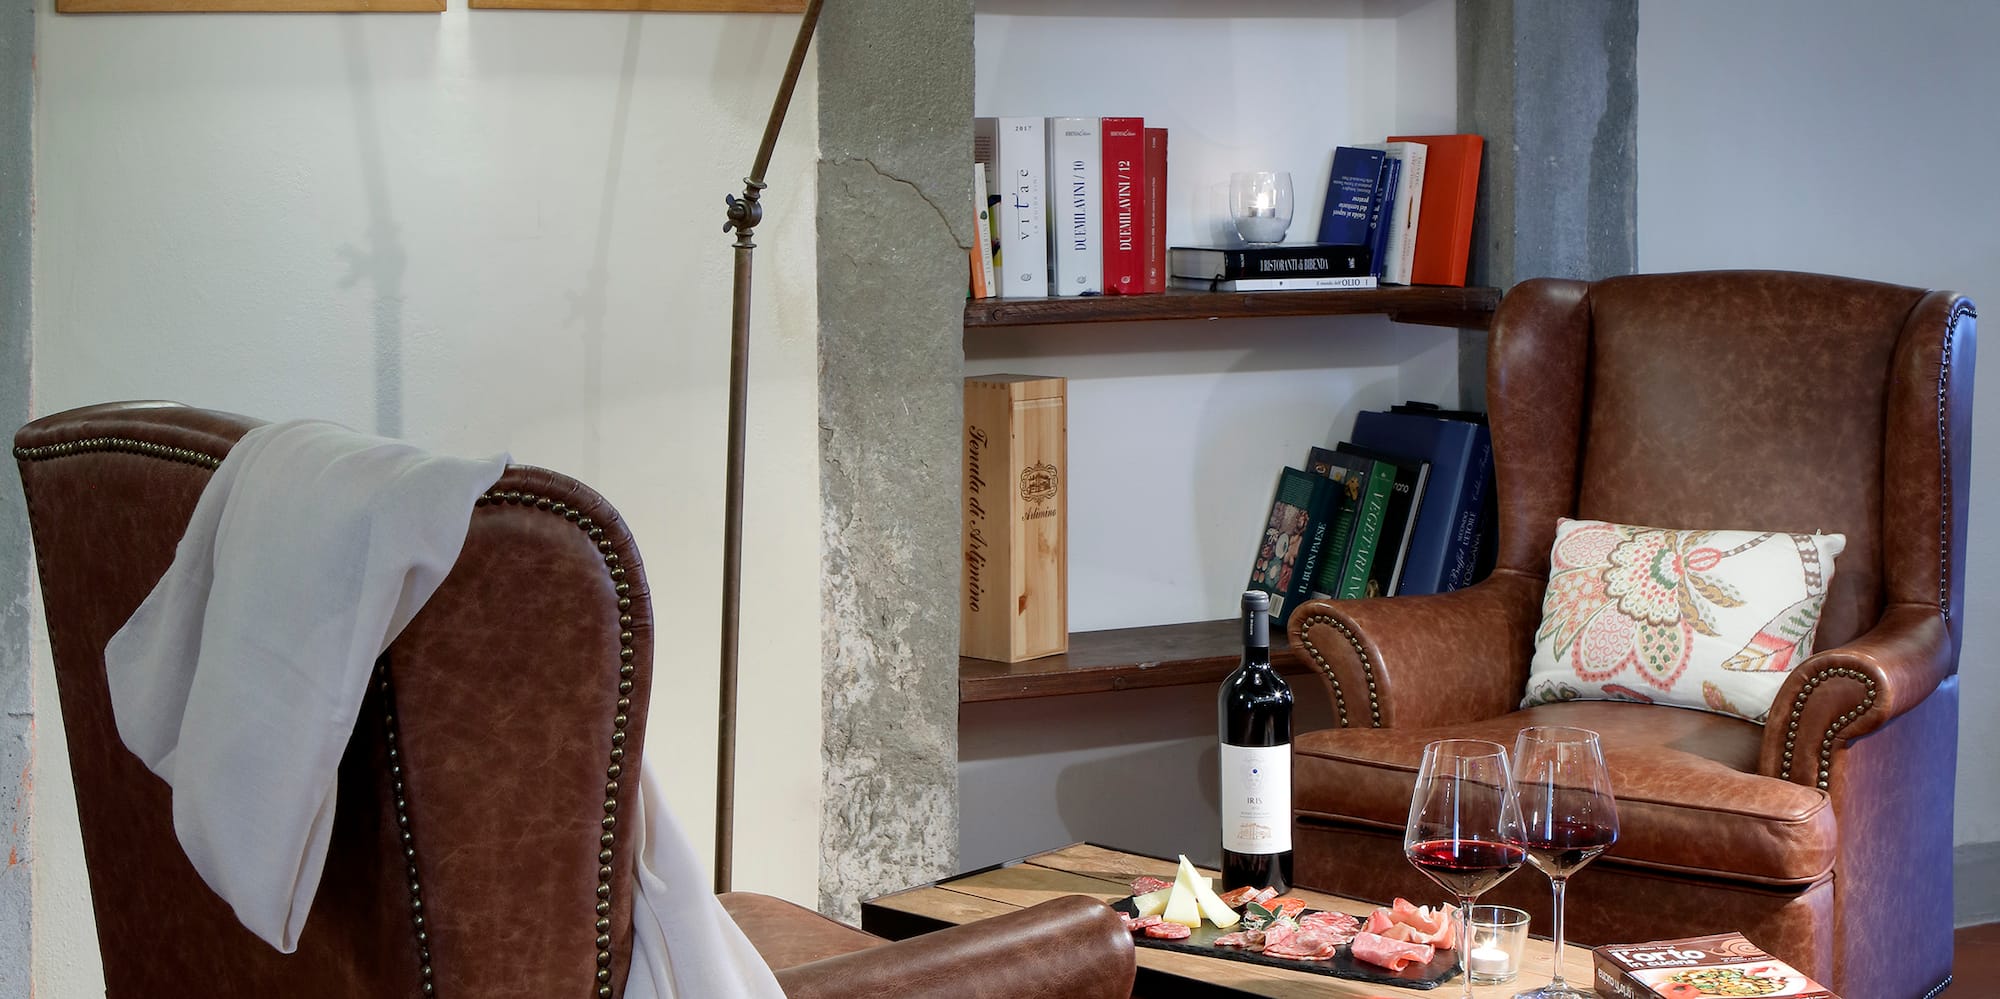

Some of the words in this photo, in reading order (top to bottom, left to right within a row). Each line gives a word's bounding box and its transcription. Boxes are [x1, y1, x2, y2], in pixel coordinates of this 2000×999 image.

[1073, 161, 1085, 171] 10
[1119, 161, 1131, 171] 12
[1074, 181, 1088, 251] DUEMILAVINI
[1119, 181, 1132, 251] DUEMILAVINI
[1264, 259, 1297, 271] RISTORANTI
[1304, 258, 1328, 270] BIBENDA
[968, 426, 988, 492] Tenuta
[969, 495, 985, 520] di
[1309, 523, 1327, 553] PAESE
[969, 520, 988, 613] Artimino
[1304, 553, 1317, 583] BUON
[1646, 959, 1699, 967] cucina
